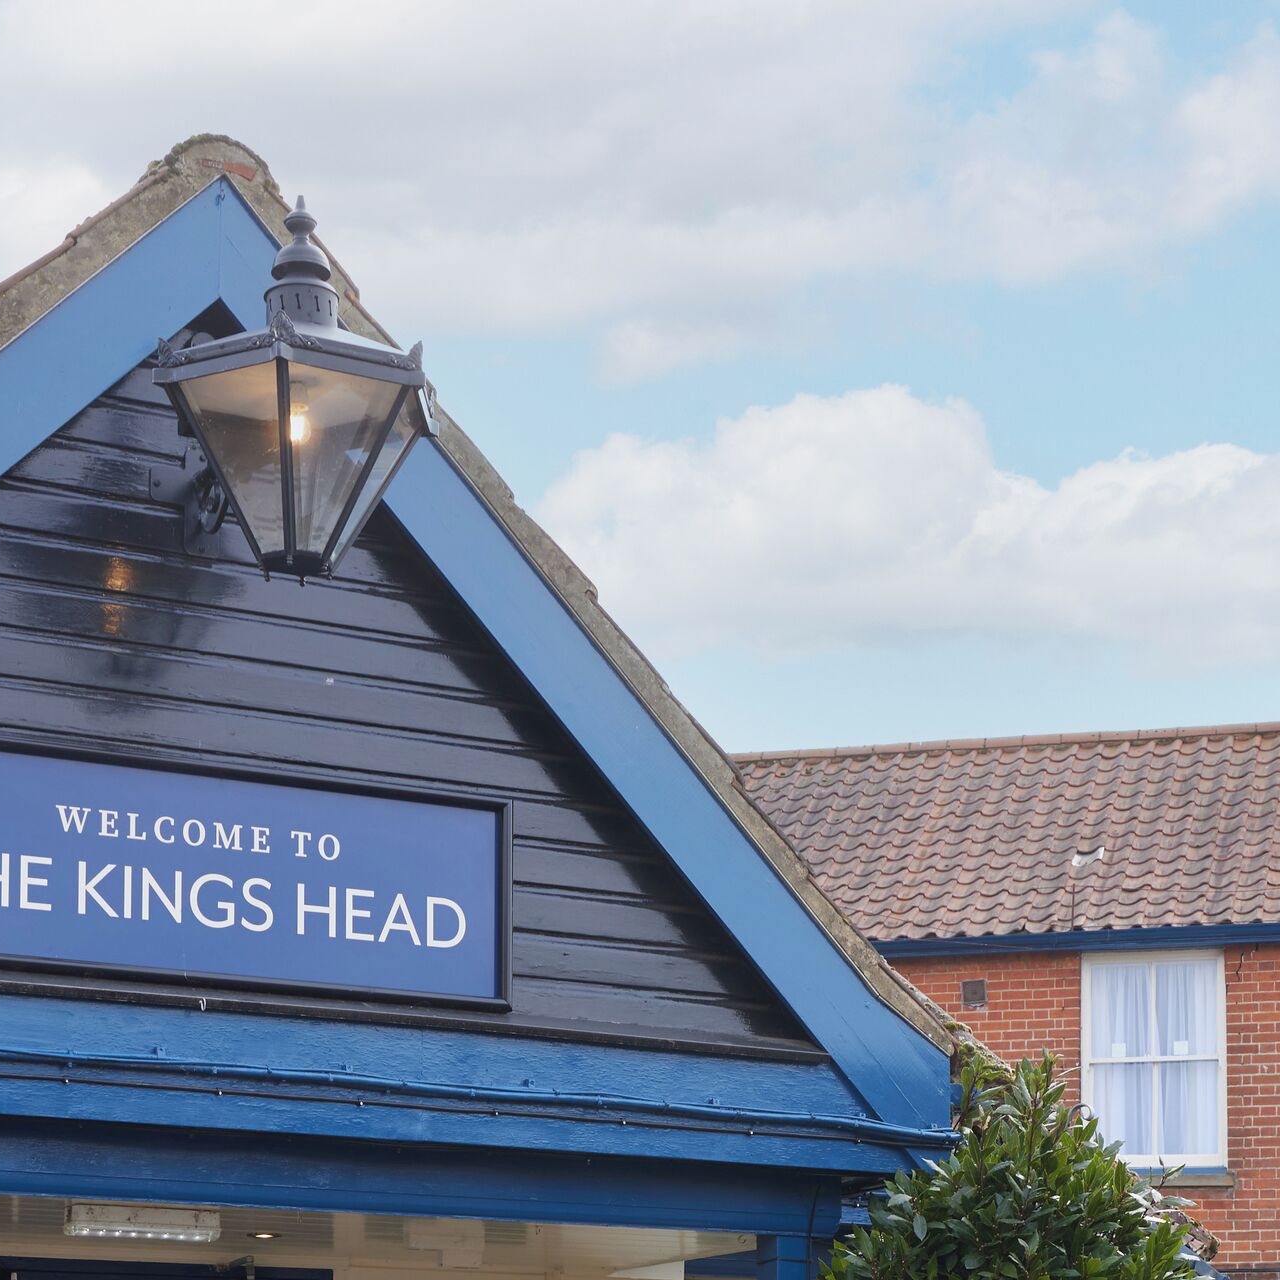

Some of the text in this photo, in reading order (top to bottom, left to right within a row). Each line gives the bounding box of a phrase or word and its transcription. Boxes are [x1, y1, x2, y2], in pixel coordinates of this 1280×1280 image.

[55, 804, 341, 861] WELCOME TO
[77, 860, 274, 932] KINGS
[297, 883, 467, 949] HEAD
